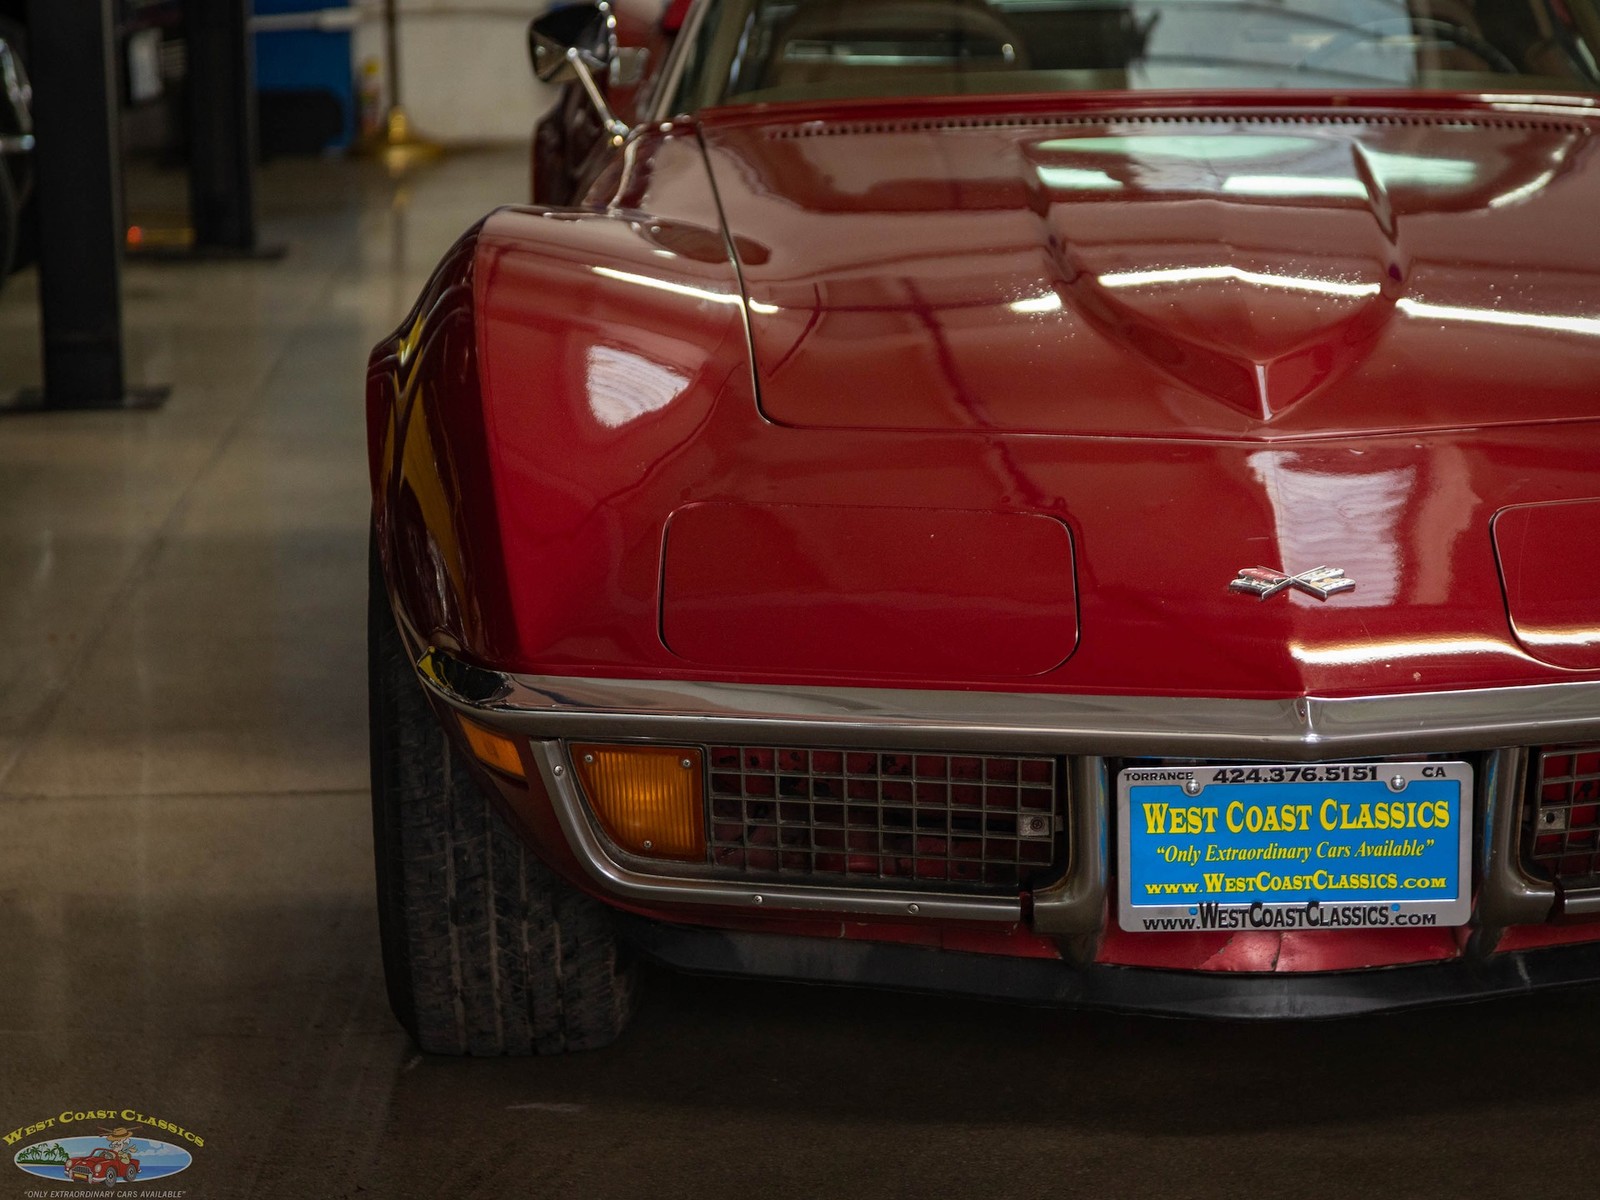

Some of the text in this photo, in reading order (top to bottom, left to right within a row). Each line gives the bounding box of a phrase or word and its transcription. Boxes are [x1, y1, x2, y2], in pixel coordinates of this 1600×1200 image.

[1124, 766, 1446, 783] TORRANCE 424.376.5151 CA
[1142, 798, 1450, 834] WEST COAST CLASSICS
[1156, 839, 1435, 866] “Only Extraordinary Cars Available”
